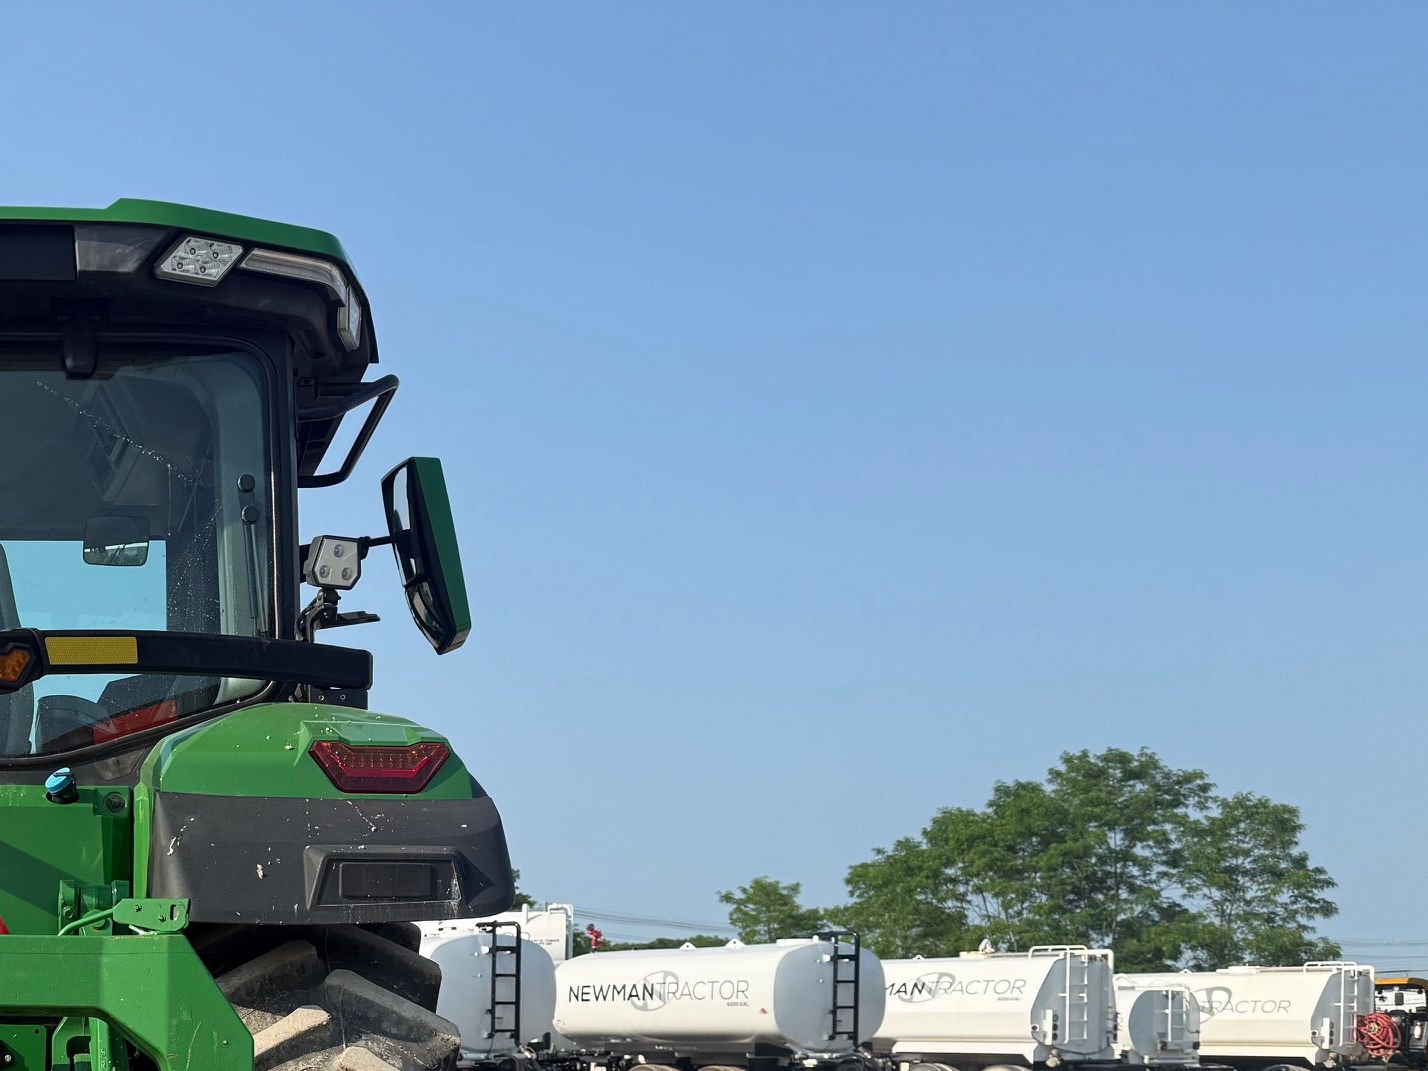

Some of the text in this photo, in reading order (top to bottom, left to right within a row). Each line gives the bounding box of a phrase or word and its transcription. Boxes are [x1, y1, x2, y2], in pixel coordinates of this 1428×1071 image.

[568, 980, 750, 1003] NEWMAN TRACTOR
[928, 979, 1027, 996] TRACTOR
